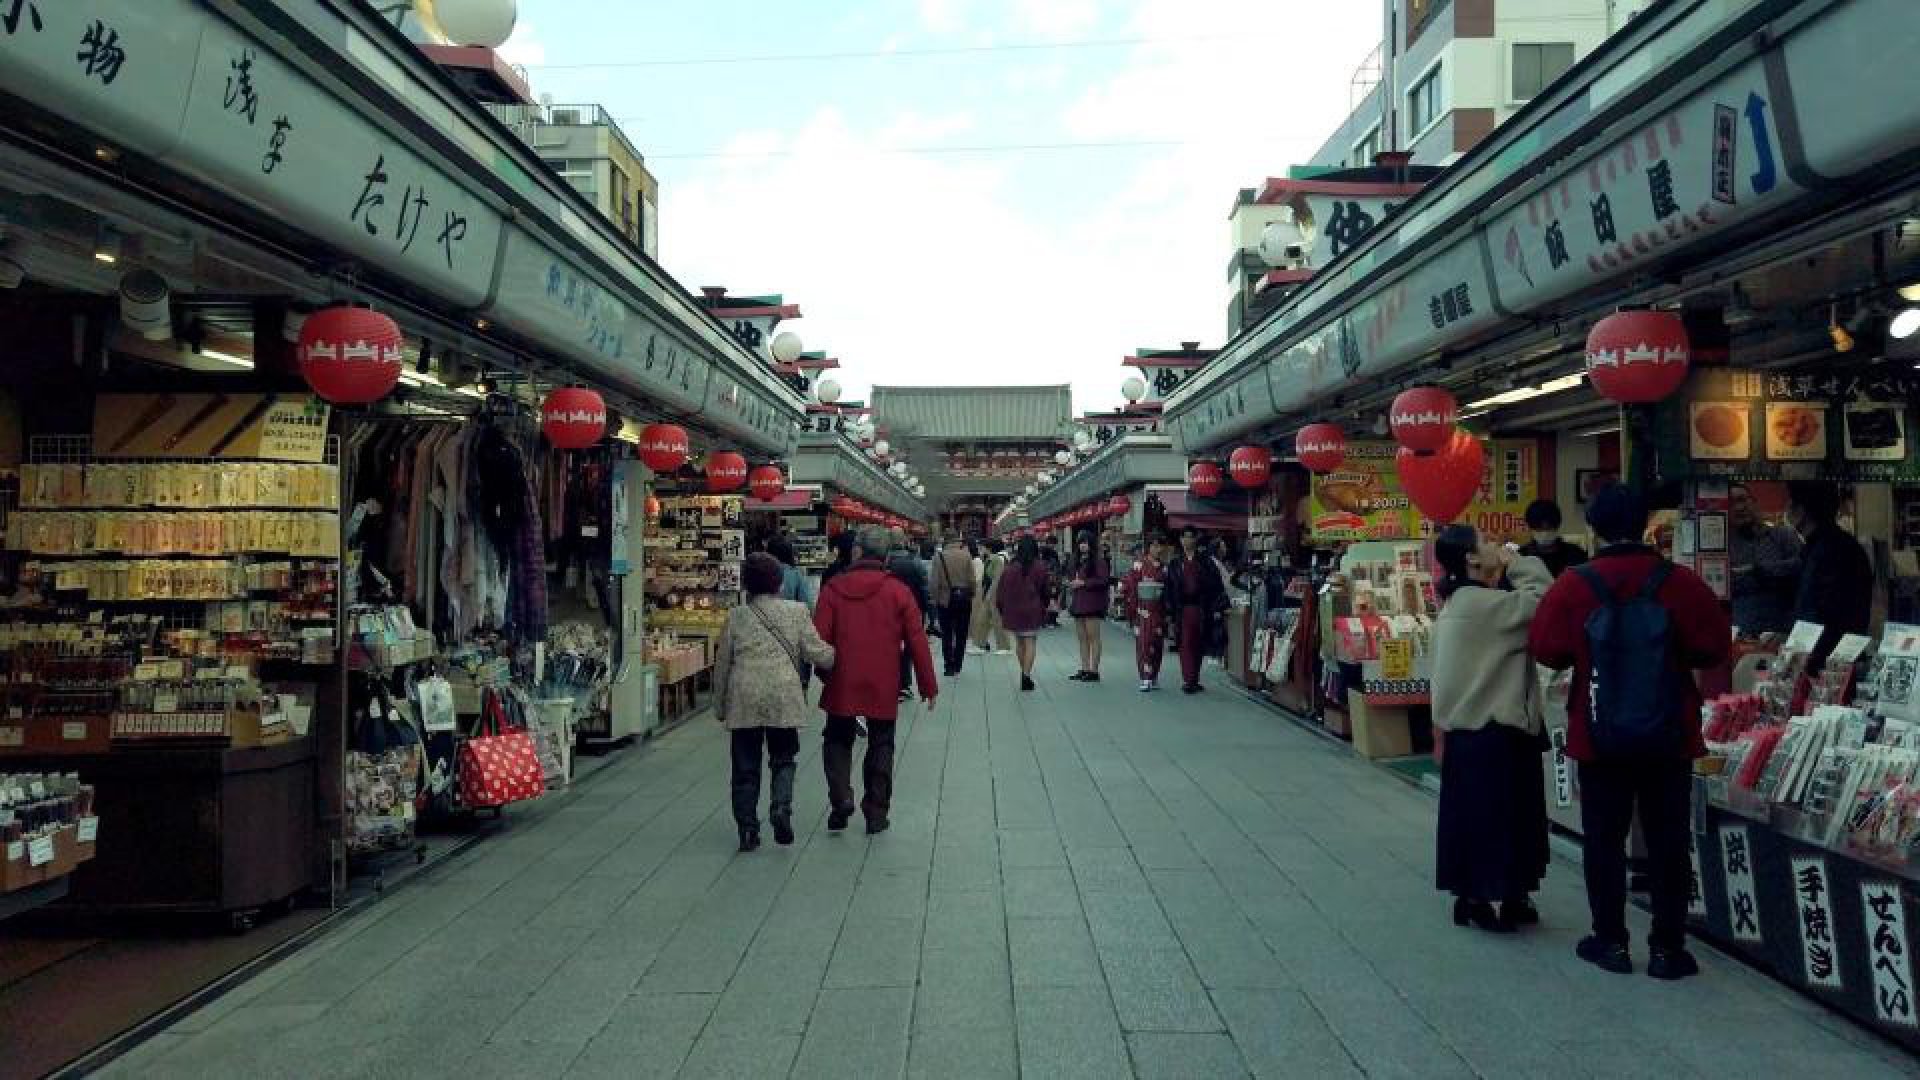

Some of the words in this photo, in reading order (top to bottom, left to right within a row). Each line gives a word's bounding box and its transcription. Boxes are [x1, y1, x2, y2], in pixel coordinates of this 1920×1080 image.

[224, 48, 292, 174] 浅草
[351, 153, 467, 268] たけや
[1797, 865, 1833, 979] 手焼き
[1868, 891, 1909, 1017] せんべい
